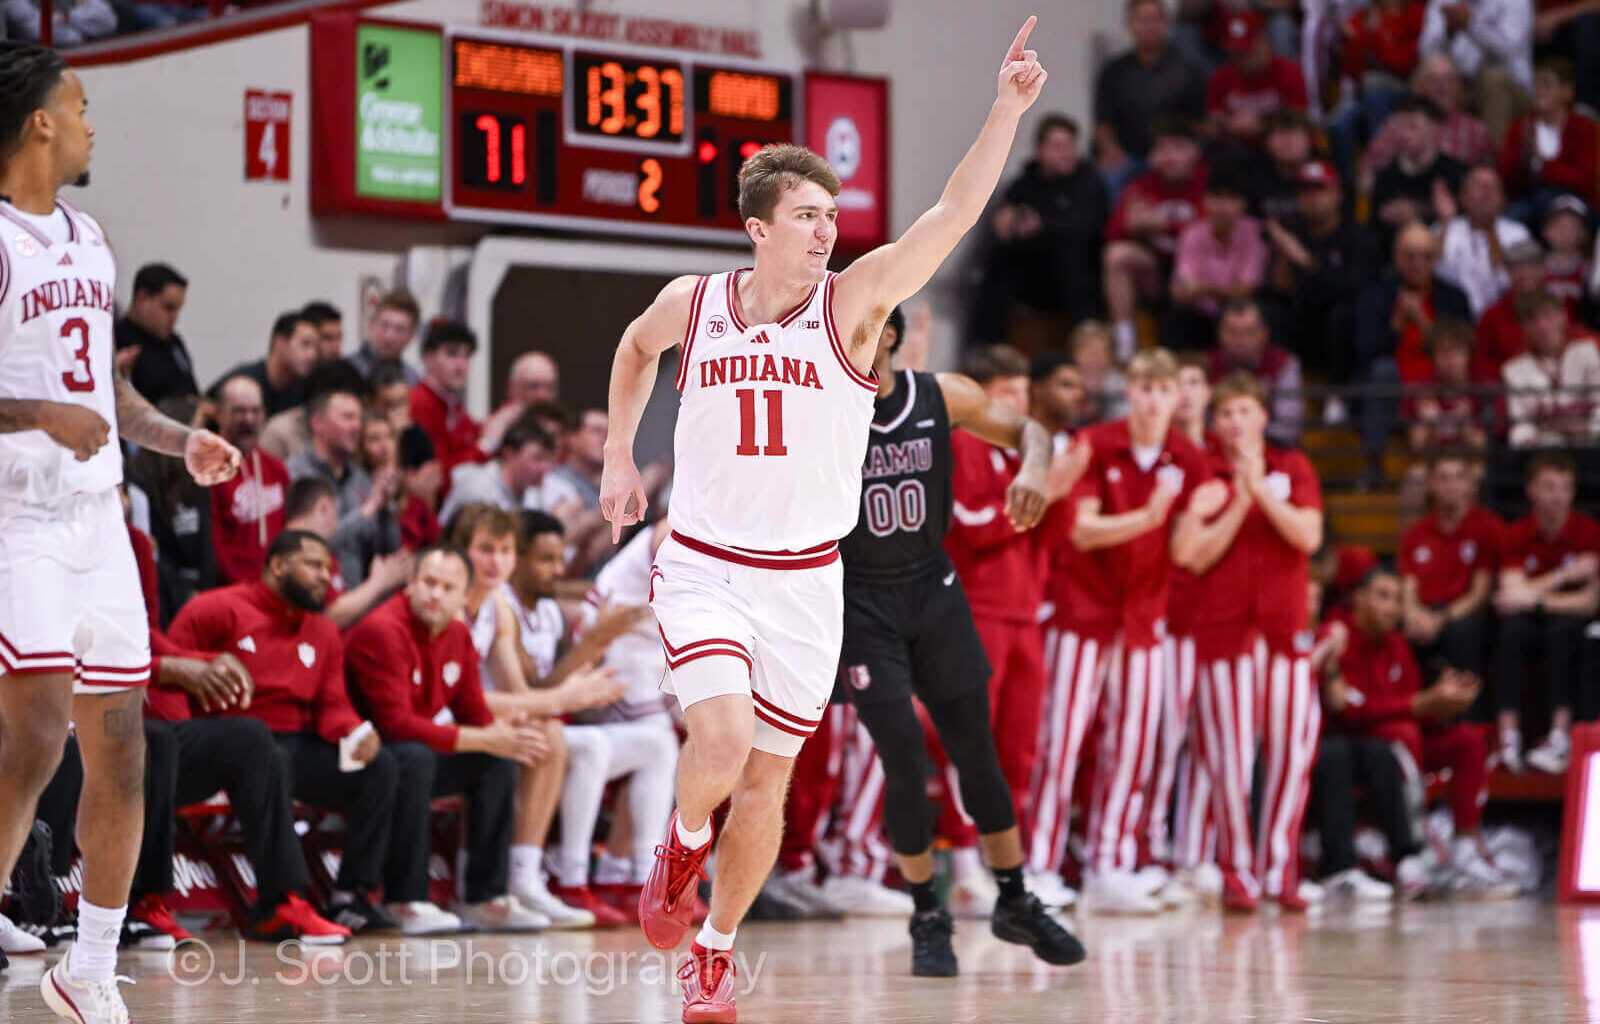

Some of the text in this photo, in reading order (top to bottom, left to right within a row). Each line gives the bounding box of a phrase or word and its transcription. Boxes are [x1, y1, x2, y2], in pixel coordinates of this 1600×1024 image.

[587, 62, 685, 138] 13:37
[258, 120, 278, 176] 4
[475, 114, 526, 185] 71
[639, 158, 663, 214] 2
[60, 316, 95, 392] 3
[700, 354, 824, 390] INDIANA
[736, 388, 788, 457] 11
[862, 437, 932, 479] AMU
[865, 479, 926, 537] 00
